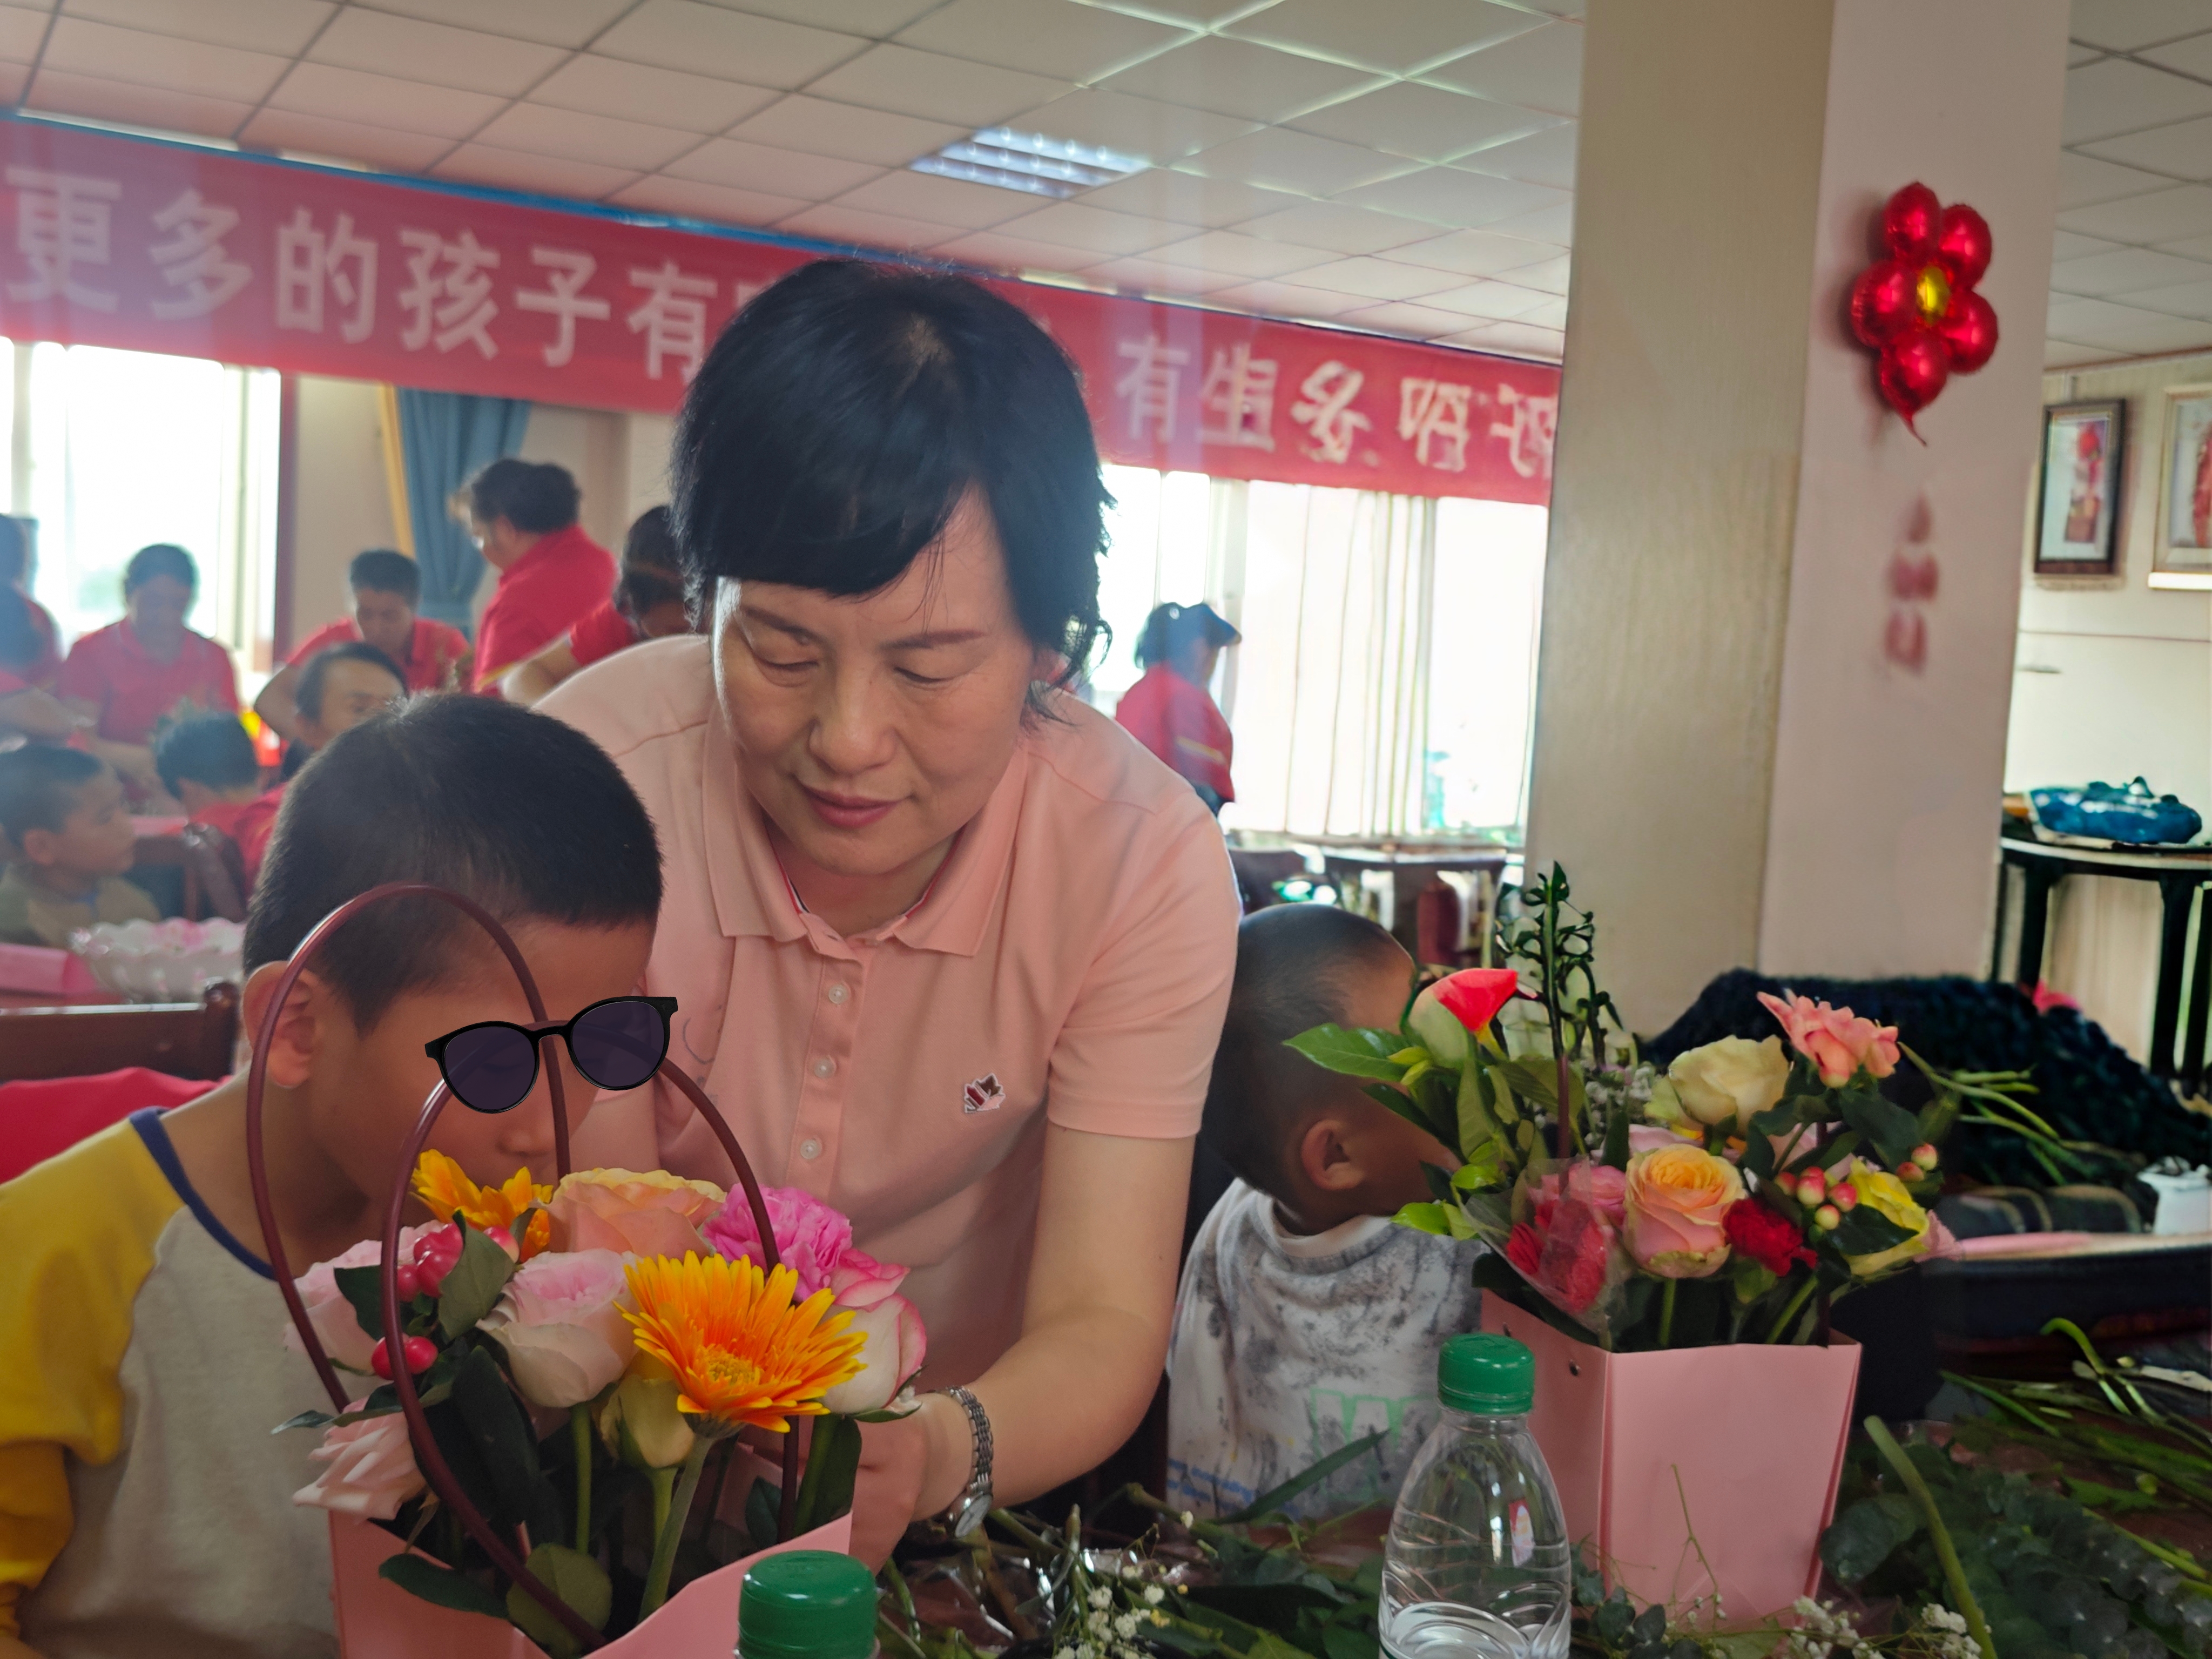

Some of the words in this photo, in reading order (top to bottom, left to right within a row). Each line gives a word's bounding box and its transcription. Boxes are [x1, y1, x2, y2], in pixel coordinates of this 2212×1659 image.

[4, 166, 773, 386] 更多的孩子有
